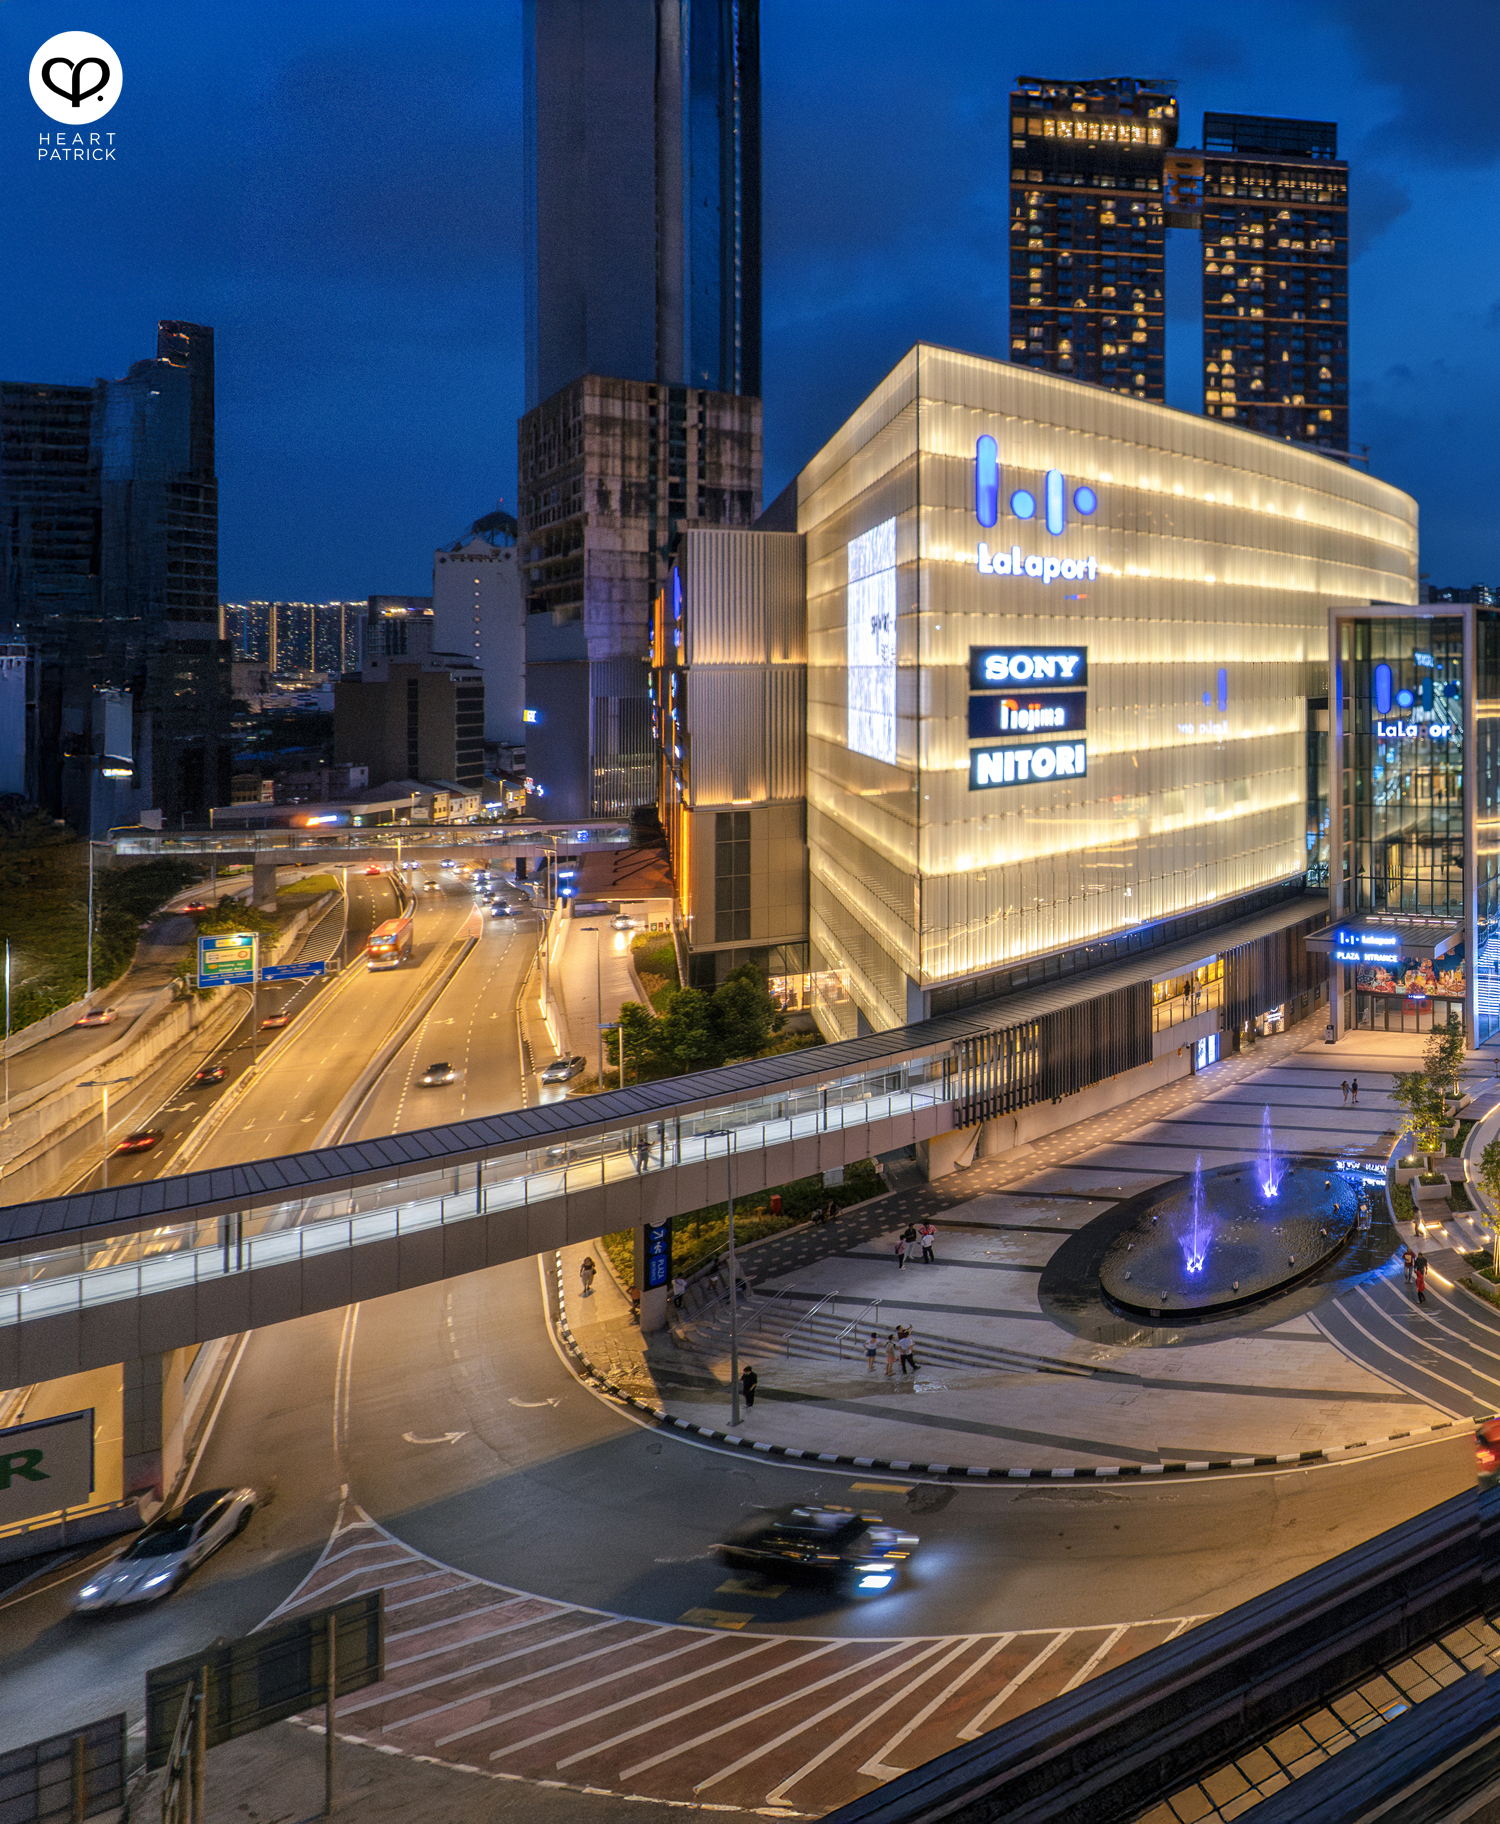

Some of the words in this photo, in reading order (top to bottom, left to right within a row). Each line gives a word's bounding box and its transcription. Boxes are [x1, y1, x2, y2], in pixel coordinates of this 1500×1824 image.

[977, 541, 1098, 585] LaLaport
[985, 654, 1079, 680] SONY
[1000, 698, 1065, 731] nojima
[976, 744, 1085, 785] NITORI
[1337, 952, 1360, 961] PLAZA
[657, 1258, 665, 1280] PLAZA
